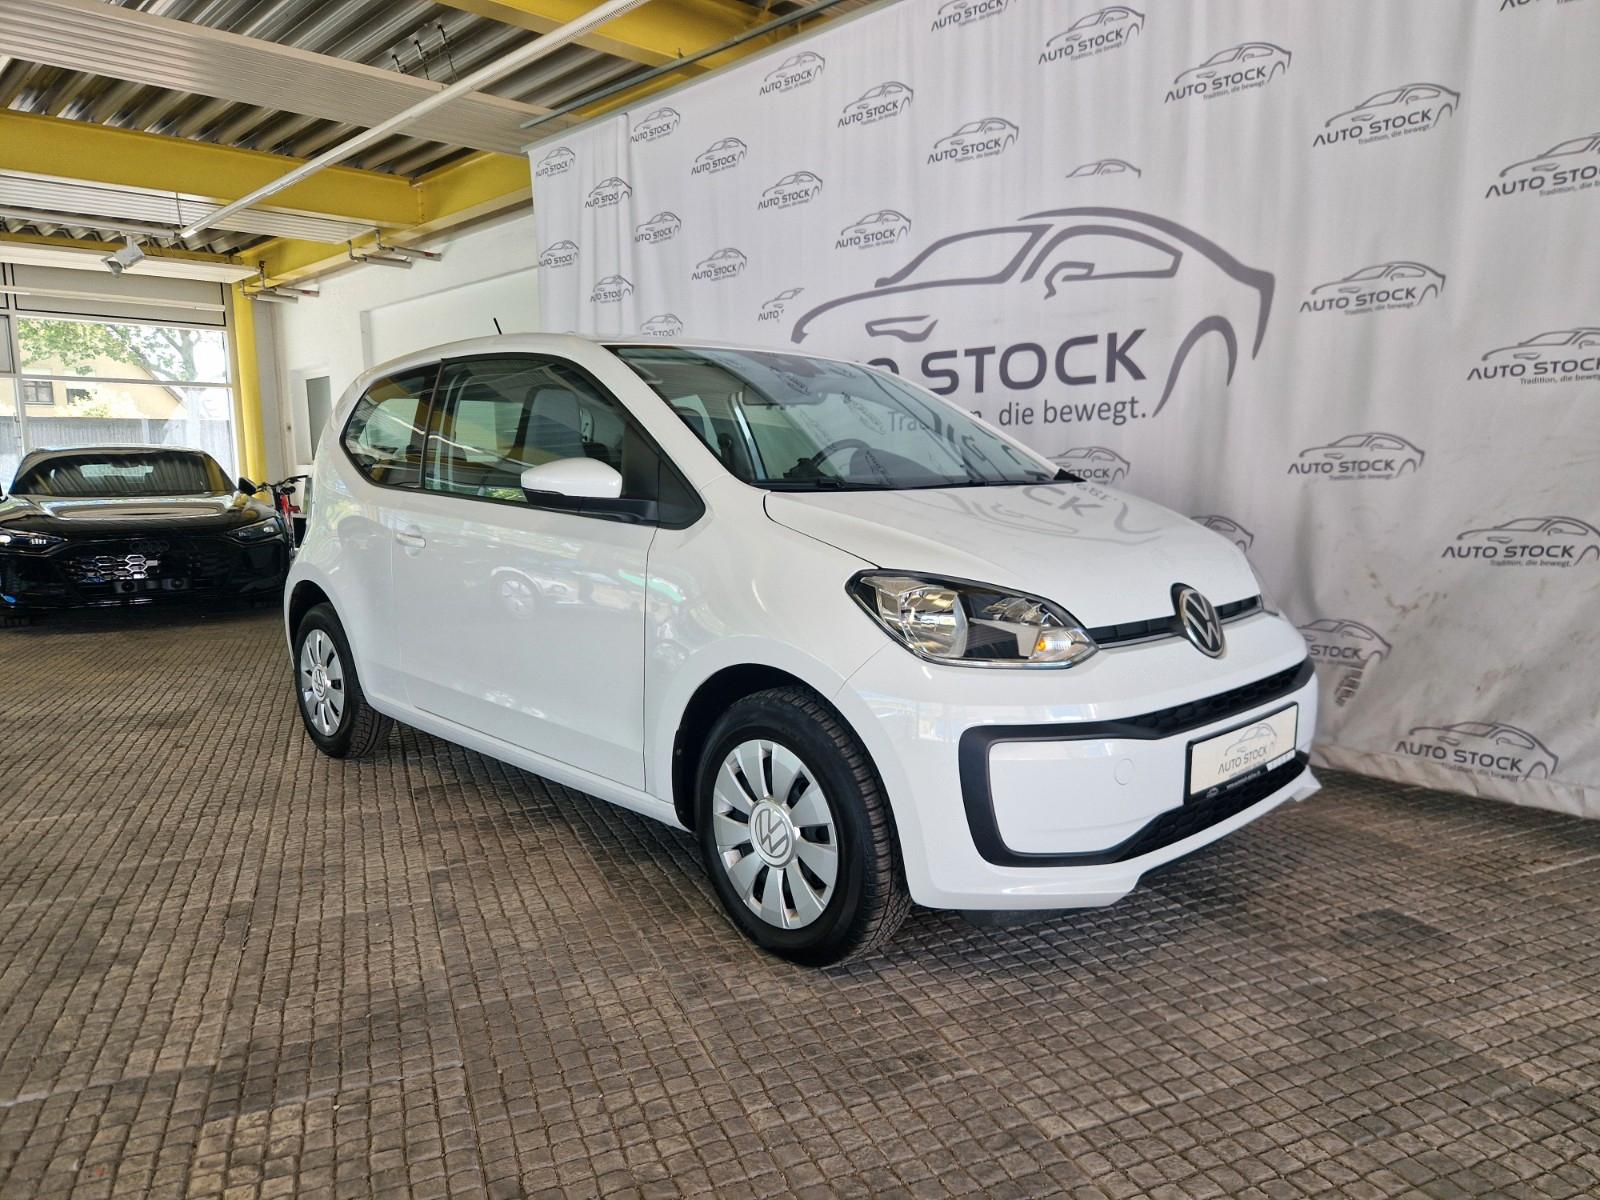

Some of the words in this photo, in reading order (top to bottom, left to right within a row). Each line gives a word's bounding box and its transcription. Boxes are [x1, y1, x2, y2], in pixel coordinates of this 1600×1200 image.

[931, 11, 962, 33] AUTO
[963, 0, 1003, 20] STOCK
[1038, 44, 1074, 65] AUTO
[1077, 27, 1124, 52] STOCK
[759, 79, 782, 97] AUTO
[783, 68, 813, 87] STOCK
[1164, 82, 1207, 104] AUTO
[1211, 65, 1267, 91] STOCK
[837, 112, 864, 129] AUTO
[865, 99, 899, 119] STOCK
[630, 131, 649, 144] AUTO
[649, 122, 672, 139] STOCK
[1312, 125, 1363, 148] AUTO
[1369, 107, 1433, 135] STOCK
[928, 148, 958, 164] AUTO
[960, 137, 1001, 156] STOCK
[691, 163, 712, 176] AUTO
[712, 152, 737, 169] STOCK
[1485, 175, 1545, 199] AUTO
[1552, 165, 1600, 187] STO
[758, 197, 780, 211] AUTO
[781, 188, 811, 205] STOCK
[835, 234, 861, 250] AUTO
[862, 227, 897, 244] STOCK
[691, 270, 712, 281] AUTO
[712, 263, 738, 278] STOCK
[1299, 297, 1350, 313] AUTO
[1355, 287, 1417, 307] STOCK
[758, 310, 780, 322] AUTO
[921, 328, 1147, 396] STOCK
[1466, 363, 1526, 381] AUTO
[1520, 376, 1558, 385] Tradition,
[1559, 374, 1573, 383] die
[998, 401, 1034, 427] die
[1042, 396, 1147, 426] bewegt.
[1287, 462, 1334, 475] AUTO
[1338, 458, 1395, 474] STOCK
[1441, 545, 1498, 559] AUTO
[1503, 544, 1575, 559] STOCK
[1309, 644, 1364, 661] STOCK
[1217, 757, 1242, 775] AUTO
[1243, 746, 1268, 763] STOCK
[1394, 740, 1447, 760] AUTO
[1453, 748, 1524, 773] STOCK
